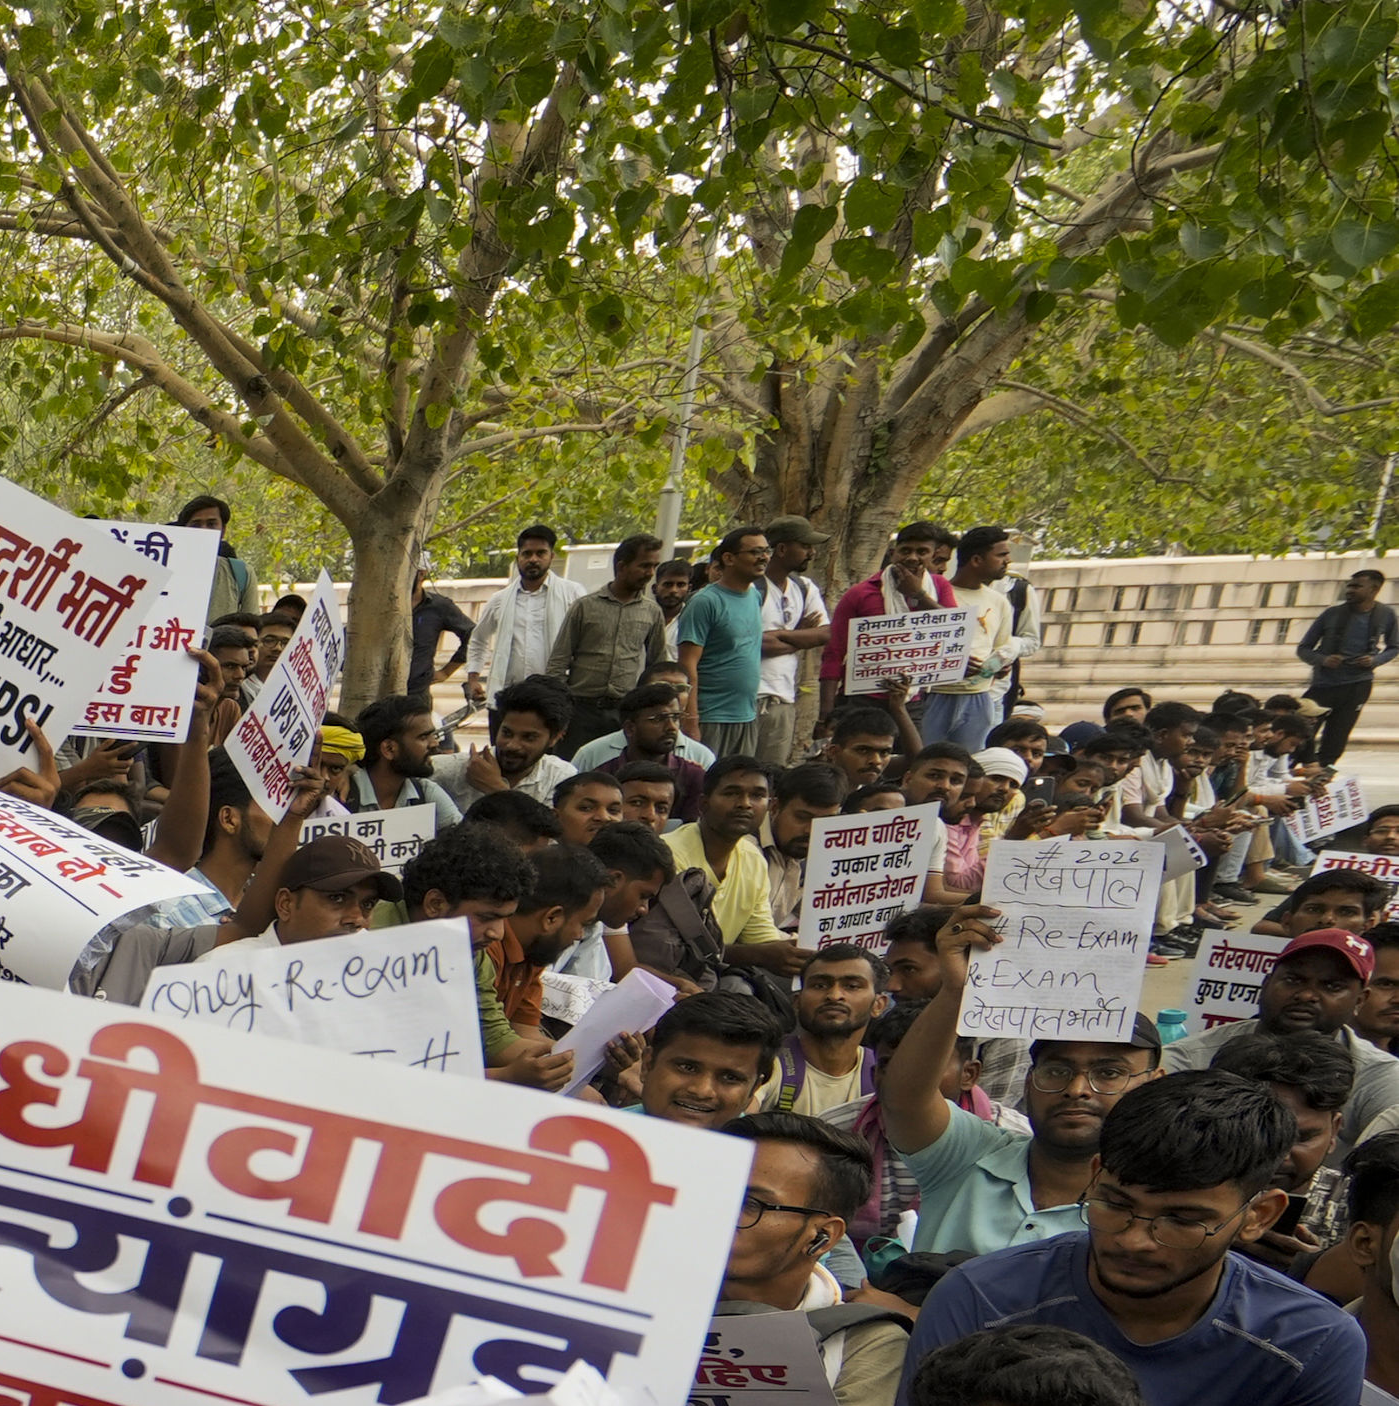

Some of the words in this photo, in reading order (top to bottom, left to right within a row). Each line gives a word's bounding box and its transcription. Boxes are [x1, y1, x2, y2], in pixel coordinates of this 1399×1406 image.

[57, 570, 147, 648] भर्ती
[911, 613, 947, 626] परीक्षा
[951, 612, 967, 621] का
[149, 618, 195, 651] और
[857, 642, 941, 663] स्कोरकार्ड
[945, 644, 964, 654] और
[84, 702, 124, 724] इस
[130, 705, 181, 728] बार!
[269, 684, 300, 738] UPSI
[357, 819, 384, 837] का
[824, 827, 869, 848] न्याय
[872, 816, 922, 844] चाहिए,
[831, 854, 880, 876] उपकार
[883, 844, 913, 868] नहीं,
[1075, 850, 1140, 864] 2026
[813, 875, 918, 909] नॉर्मलाइजेशन
[1003, 858, 1145, 908] लेखपाल
